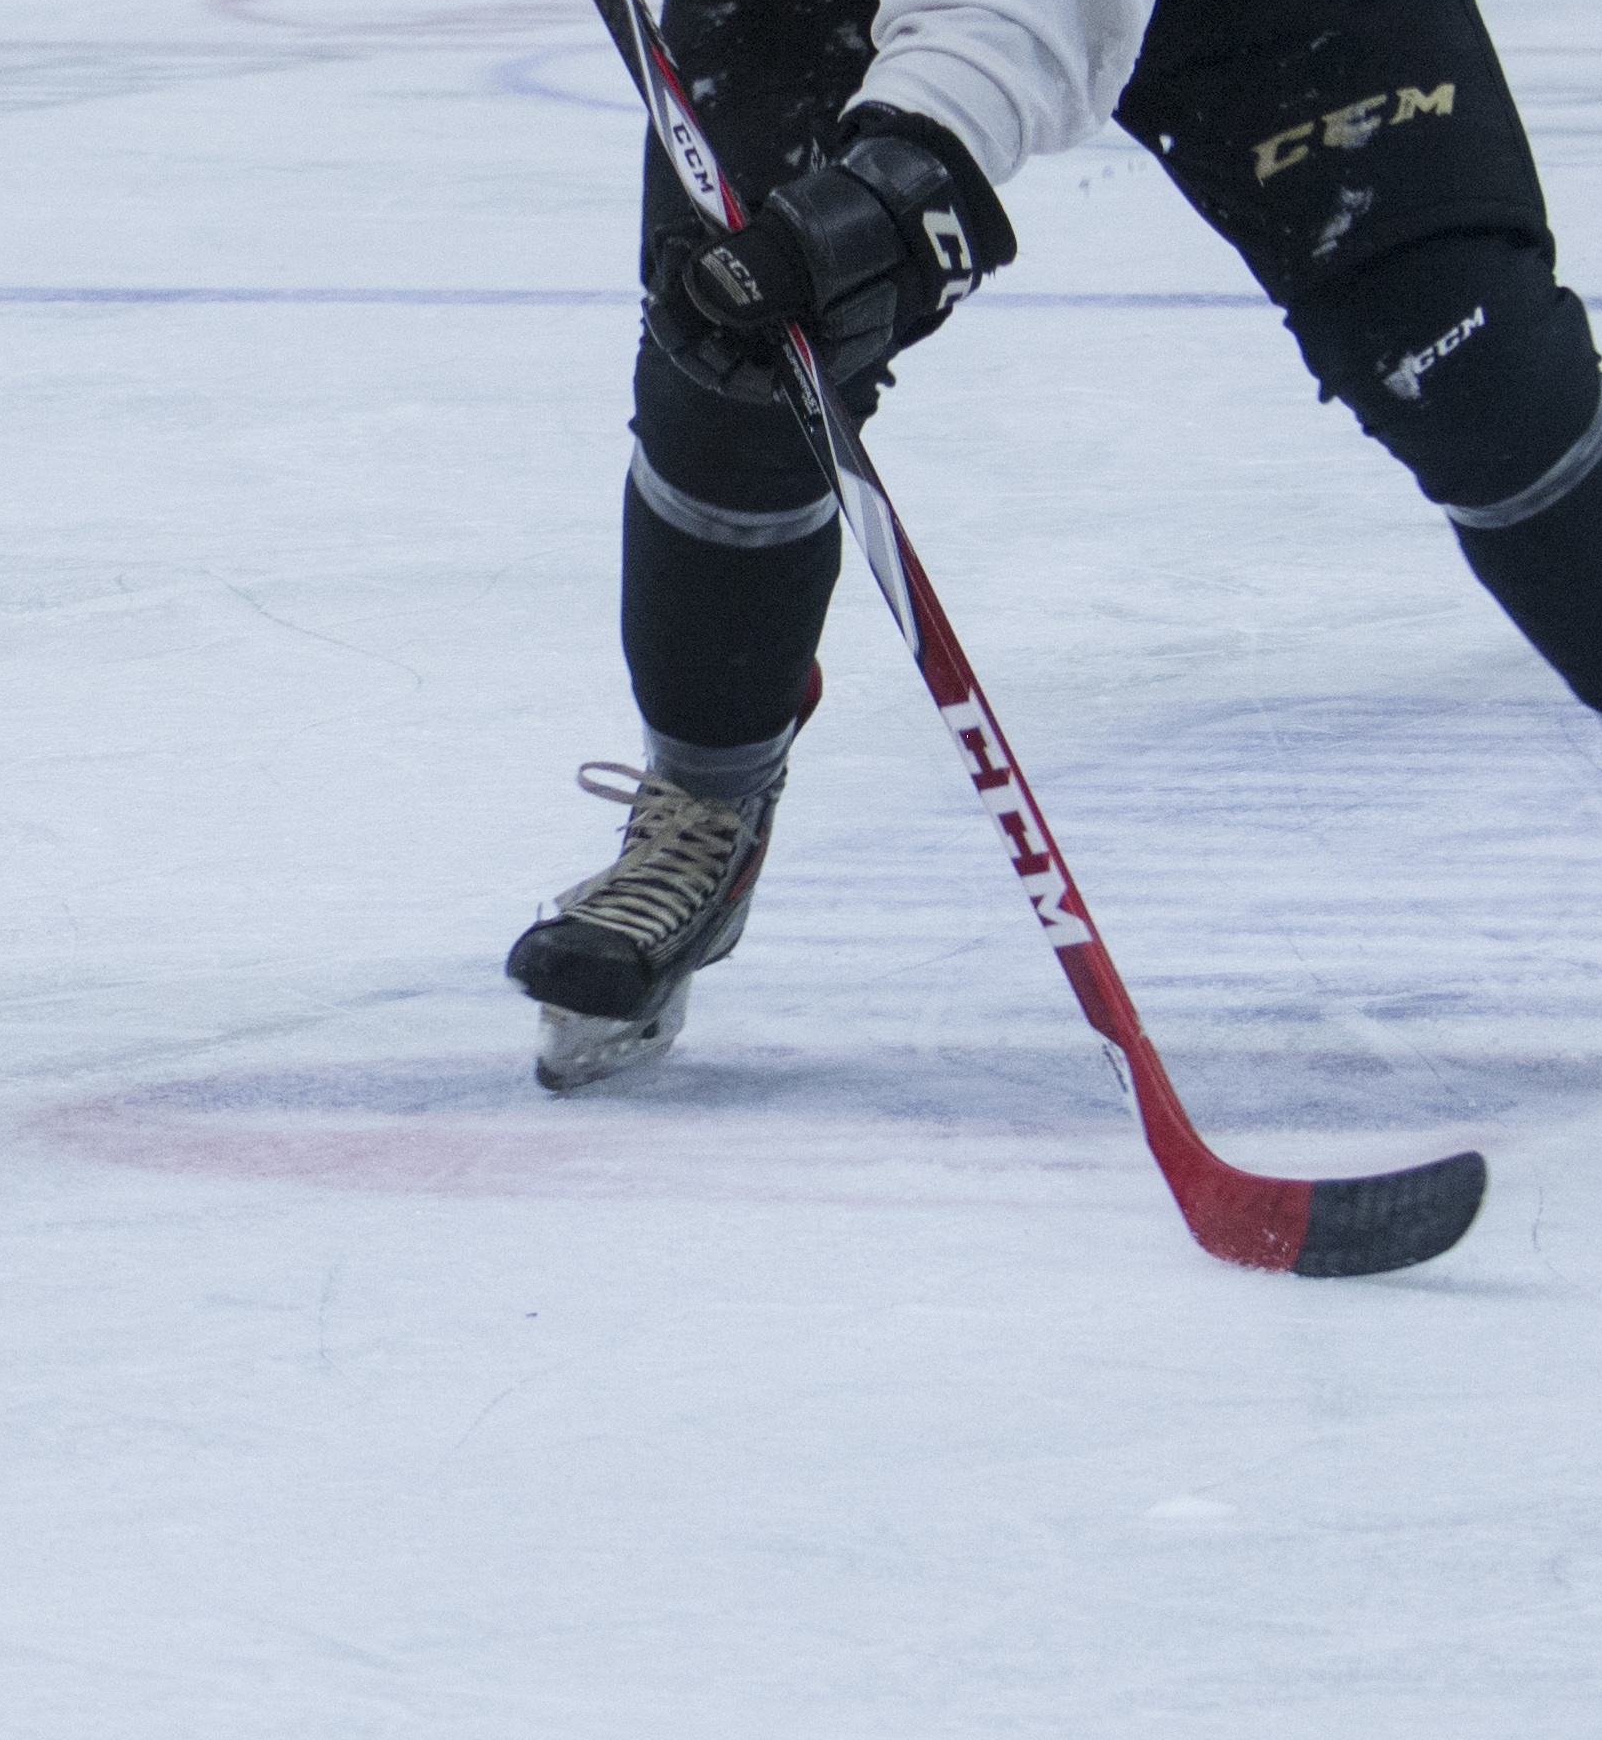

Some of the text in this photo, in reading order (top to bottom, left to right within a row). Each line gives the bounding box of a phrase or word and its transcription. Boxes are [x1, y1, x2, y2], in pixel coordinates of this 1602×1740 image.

[672, 122, 713, 194] CCM
[712, 246, 763, 301] CCM
[1412, 307, 1485, 375] CCM
[941, 688, 1092, 951] CCM
